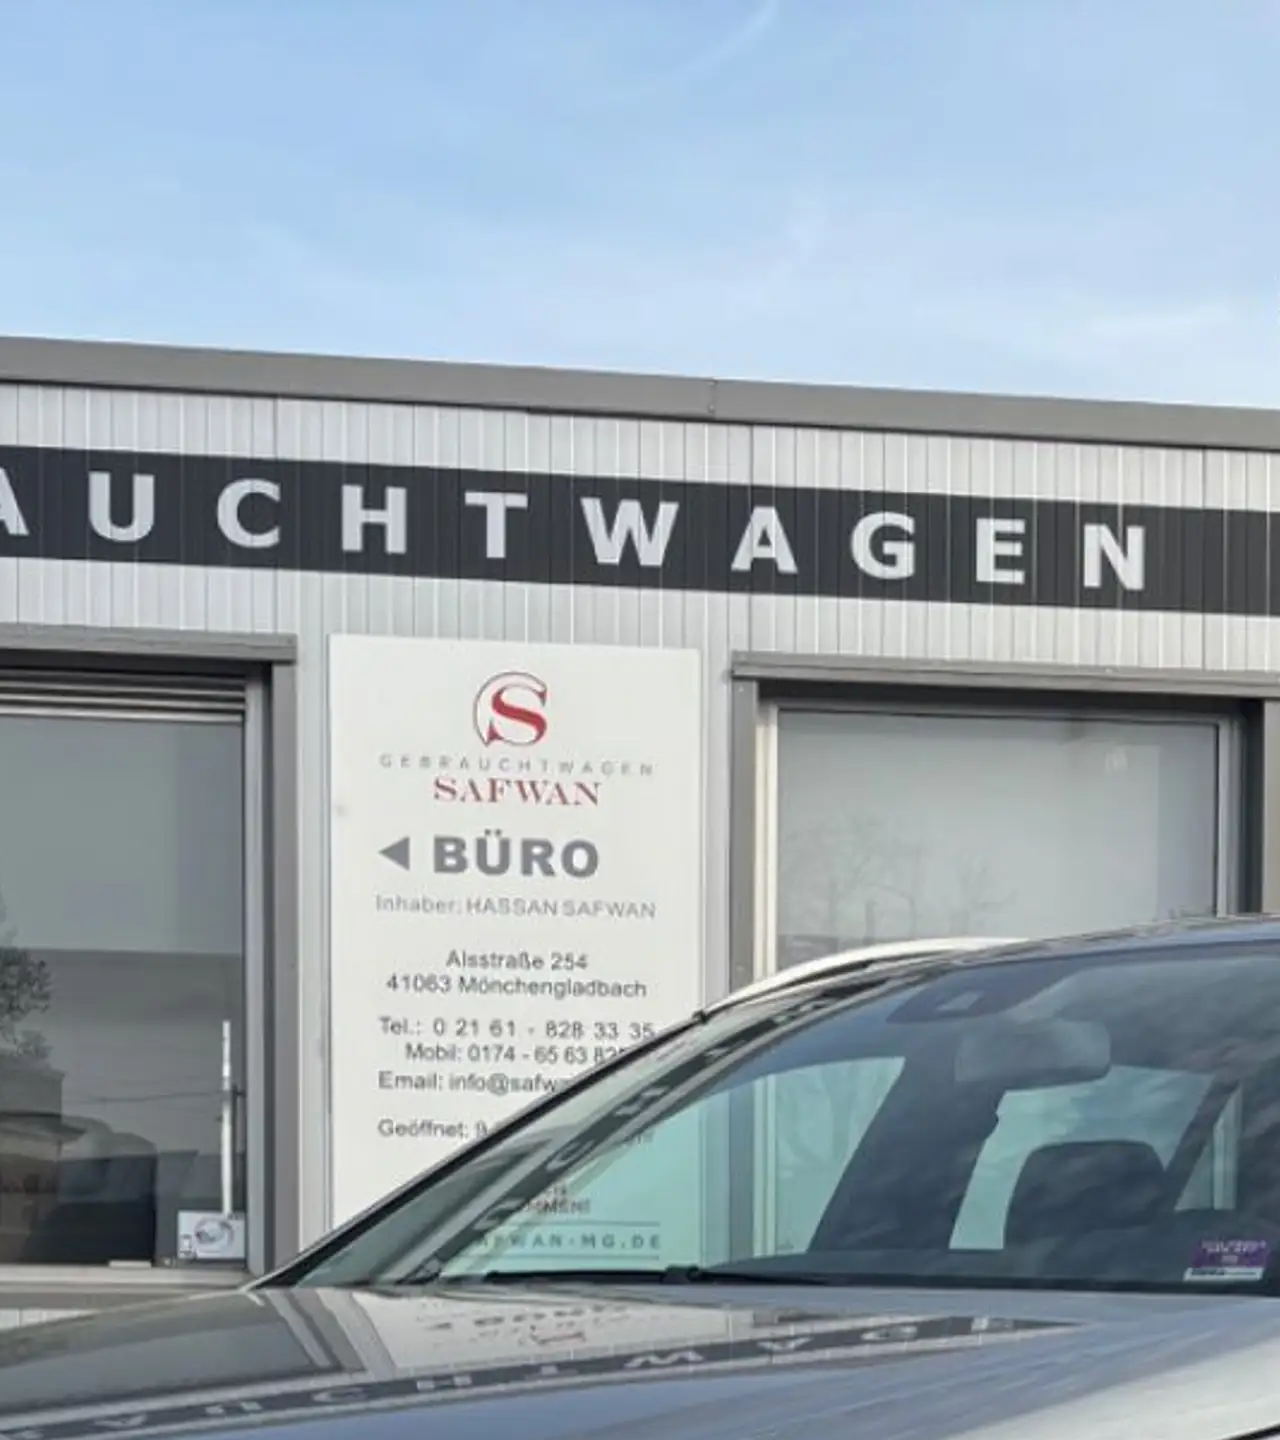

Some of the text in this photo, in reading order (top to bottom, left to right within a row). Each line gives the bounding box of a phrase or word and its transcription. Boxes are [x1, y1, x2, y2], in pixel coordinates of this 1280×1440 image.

[379, 753, 654, 776] GEBRAUCHTWAGEN
[433, 775, 602, 806] SAFWAN
[433, 829, 600, 878] BÜRO
[376, 895, 656, 919] Inhaber: HASSAN SAFWAN
[446, 949, 588, 971] Alsstraße 254
[386, 974, 646, 1000] 41063 Mönchengladbach
[433, 1017, 445, 1037] 0
[456, 1018, 479, 1037] 21
[489, 1019, 516, 1039] 61
[546, 1021, 584, 1040] 828
[594, 1022, 618, 1040] 33
[405, 1043, 462, 1062] Mobil:
[468, 1045, 515, 1062] 0174
[593, 1048, 626, 1068] 82
[378, 1071, 570, 1095] Email: info@safw
[378, 1119, 468, 1139] Geöffnet:
